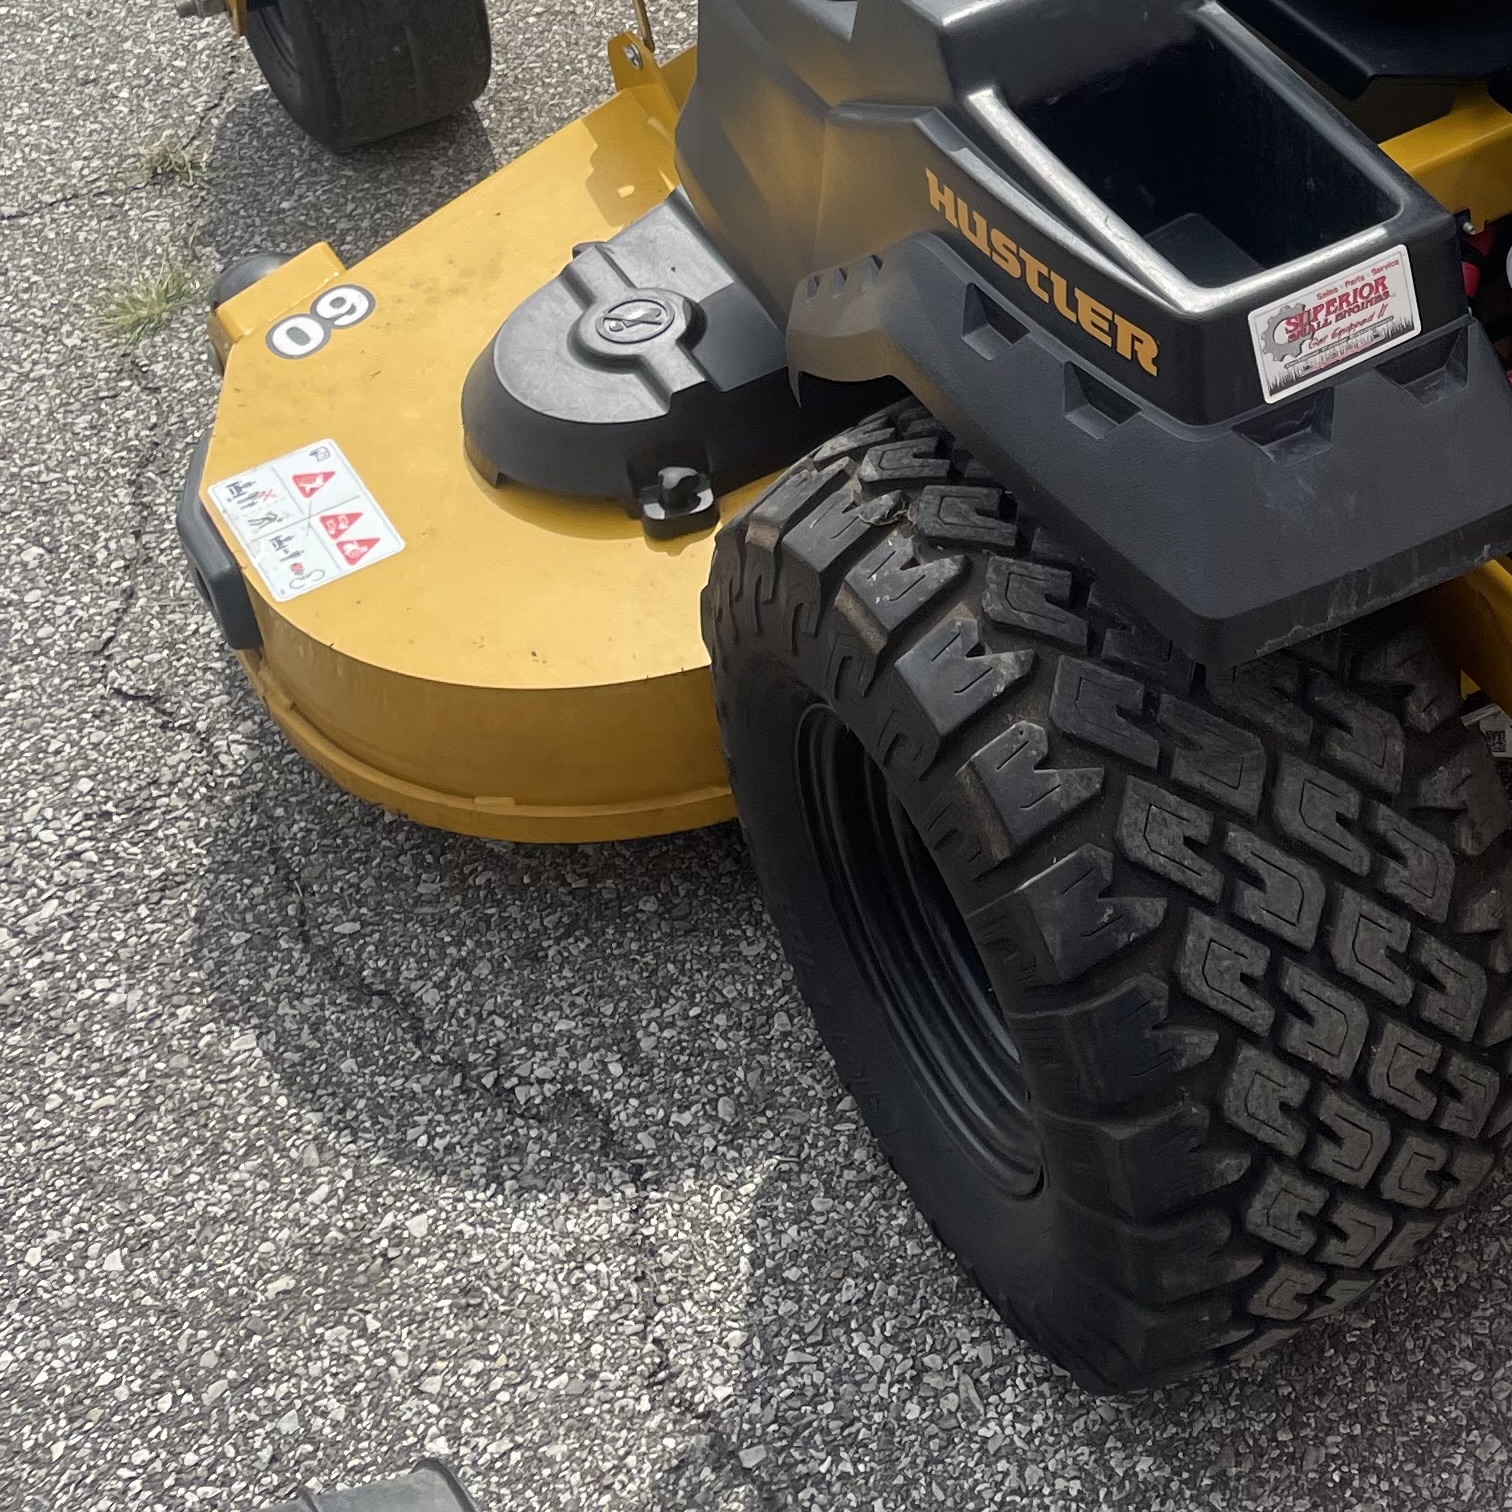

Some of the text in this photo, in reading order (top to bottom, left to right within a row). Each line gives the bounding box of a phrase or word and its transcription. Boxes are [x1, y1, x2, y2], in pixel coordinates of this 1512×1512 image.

[925, 168, 1159, 377] HUSTLER
[1371, 259, 1400, 276] Service
[268, 285, 374, 358] 60
[1285, 275, 1389, 334] SUPERIOR
[1287, 317, 1333, 344] SMALL
